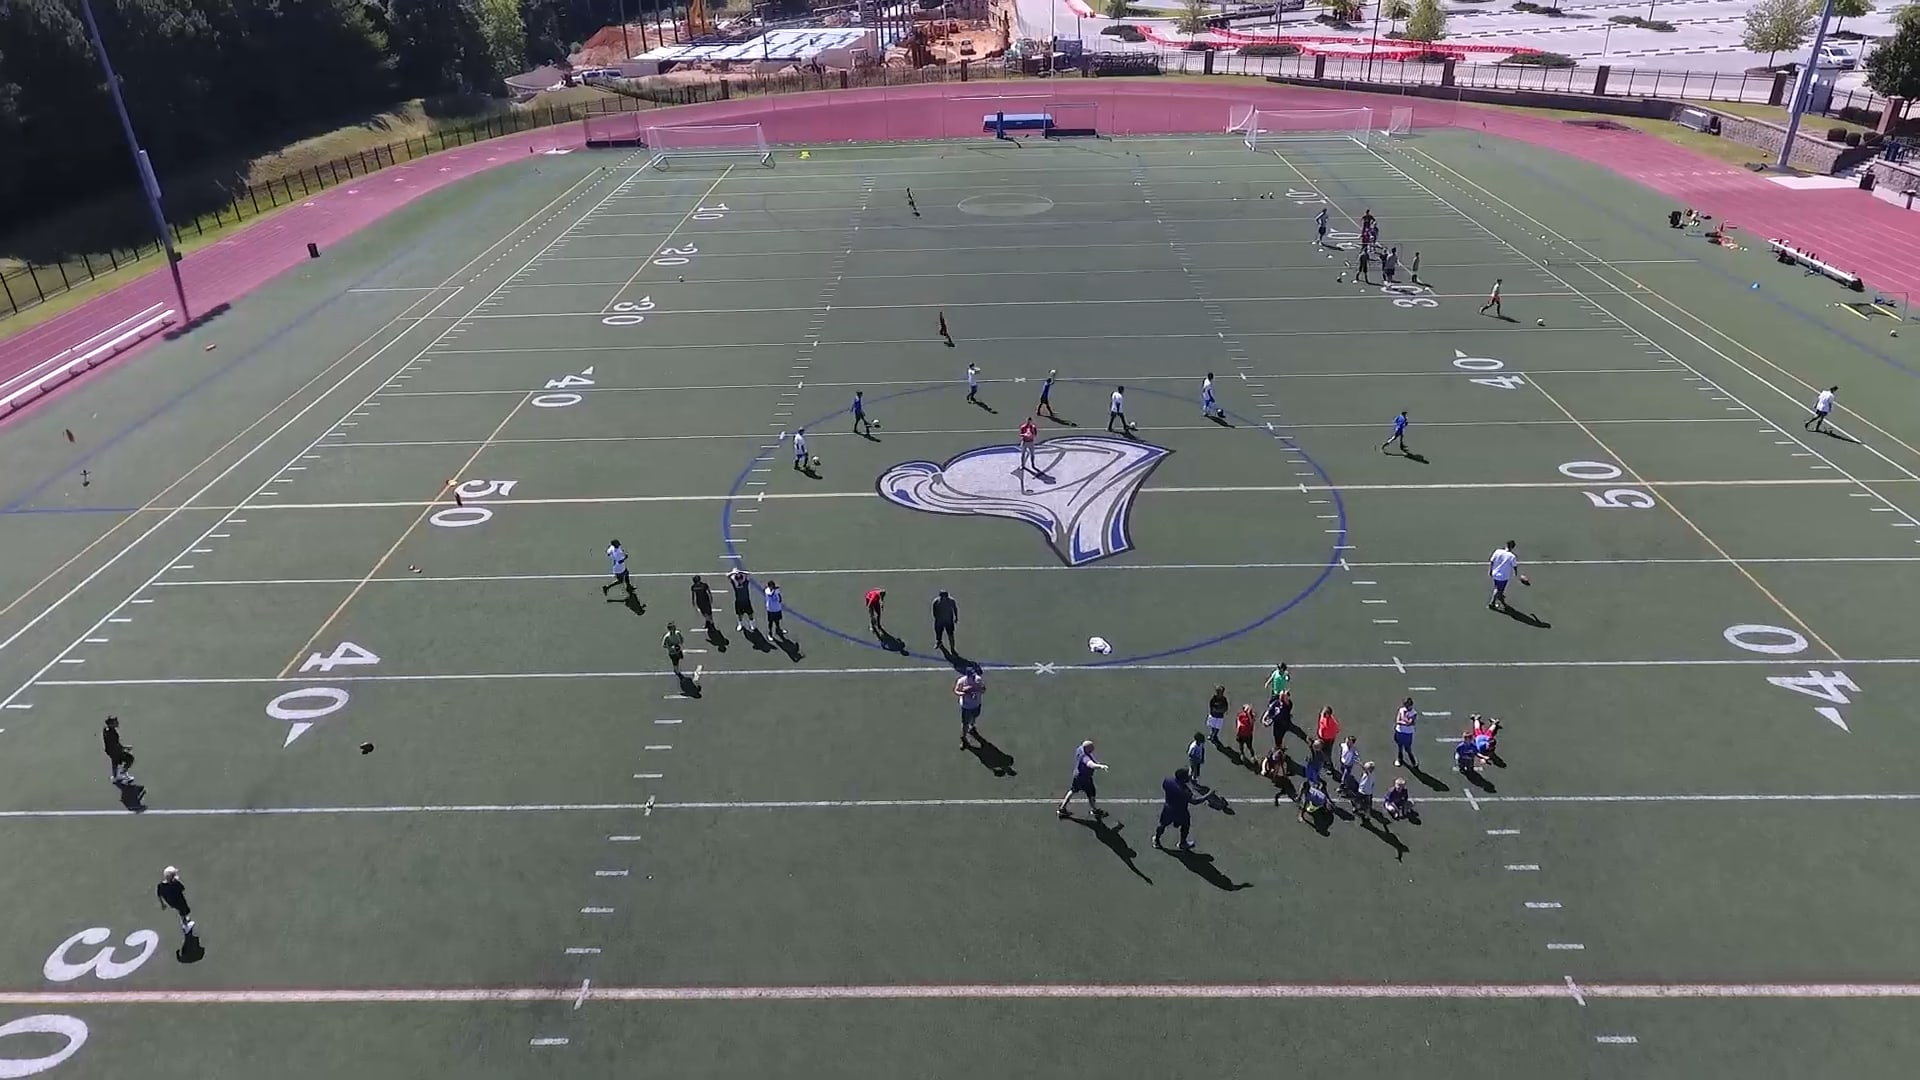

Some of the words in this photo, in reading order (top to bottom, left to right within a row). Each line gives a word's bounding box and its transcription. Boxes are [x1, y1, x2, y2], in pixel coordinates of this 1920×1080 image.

[691, 204, 729, 220] 10
[1284, 191, 1327, 205] 10
[653, 247, 698, 265] 20
[1381, 285, 1439, 308] 30
[602, 302, 655, 325] 30
[1453, 358, 1525, 389] 40
[531, 375, 595, 407] 40
[1558, 461, 1655, 508] 50
[430, 479, 519, 527] 50
[1723, 624, 1863, 704] 40
[266, 641, 381, 720] 40
[0, 927, 159, 1079] 30
